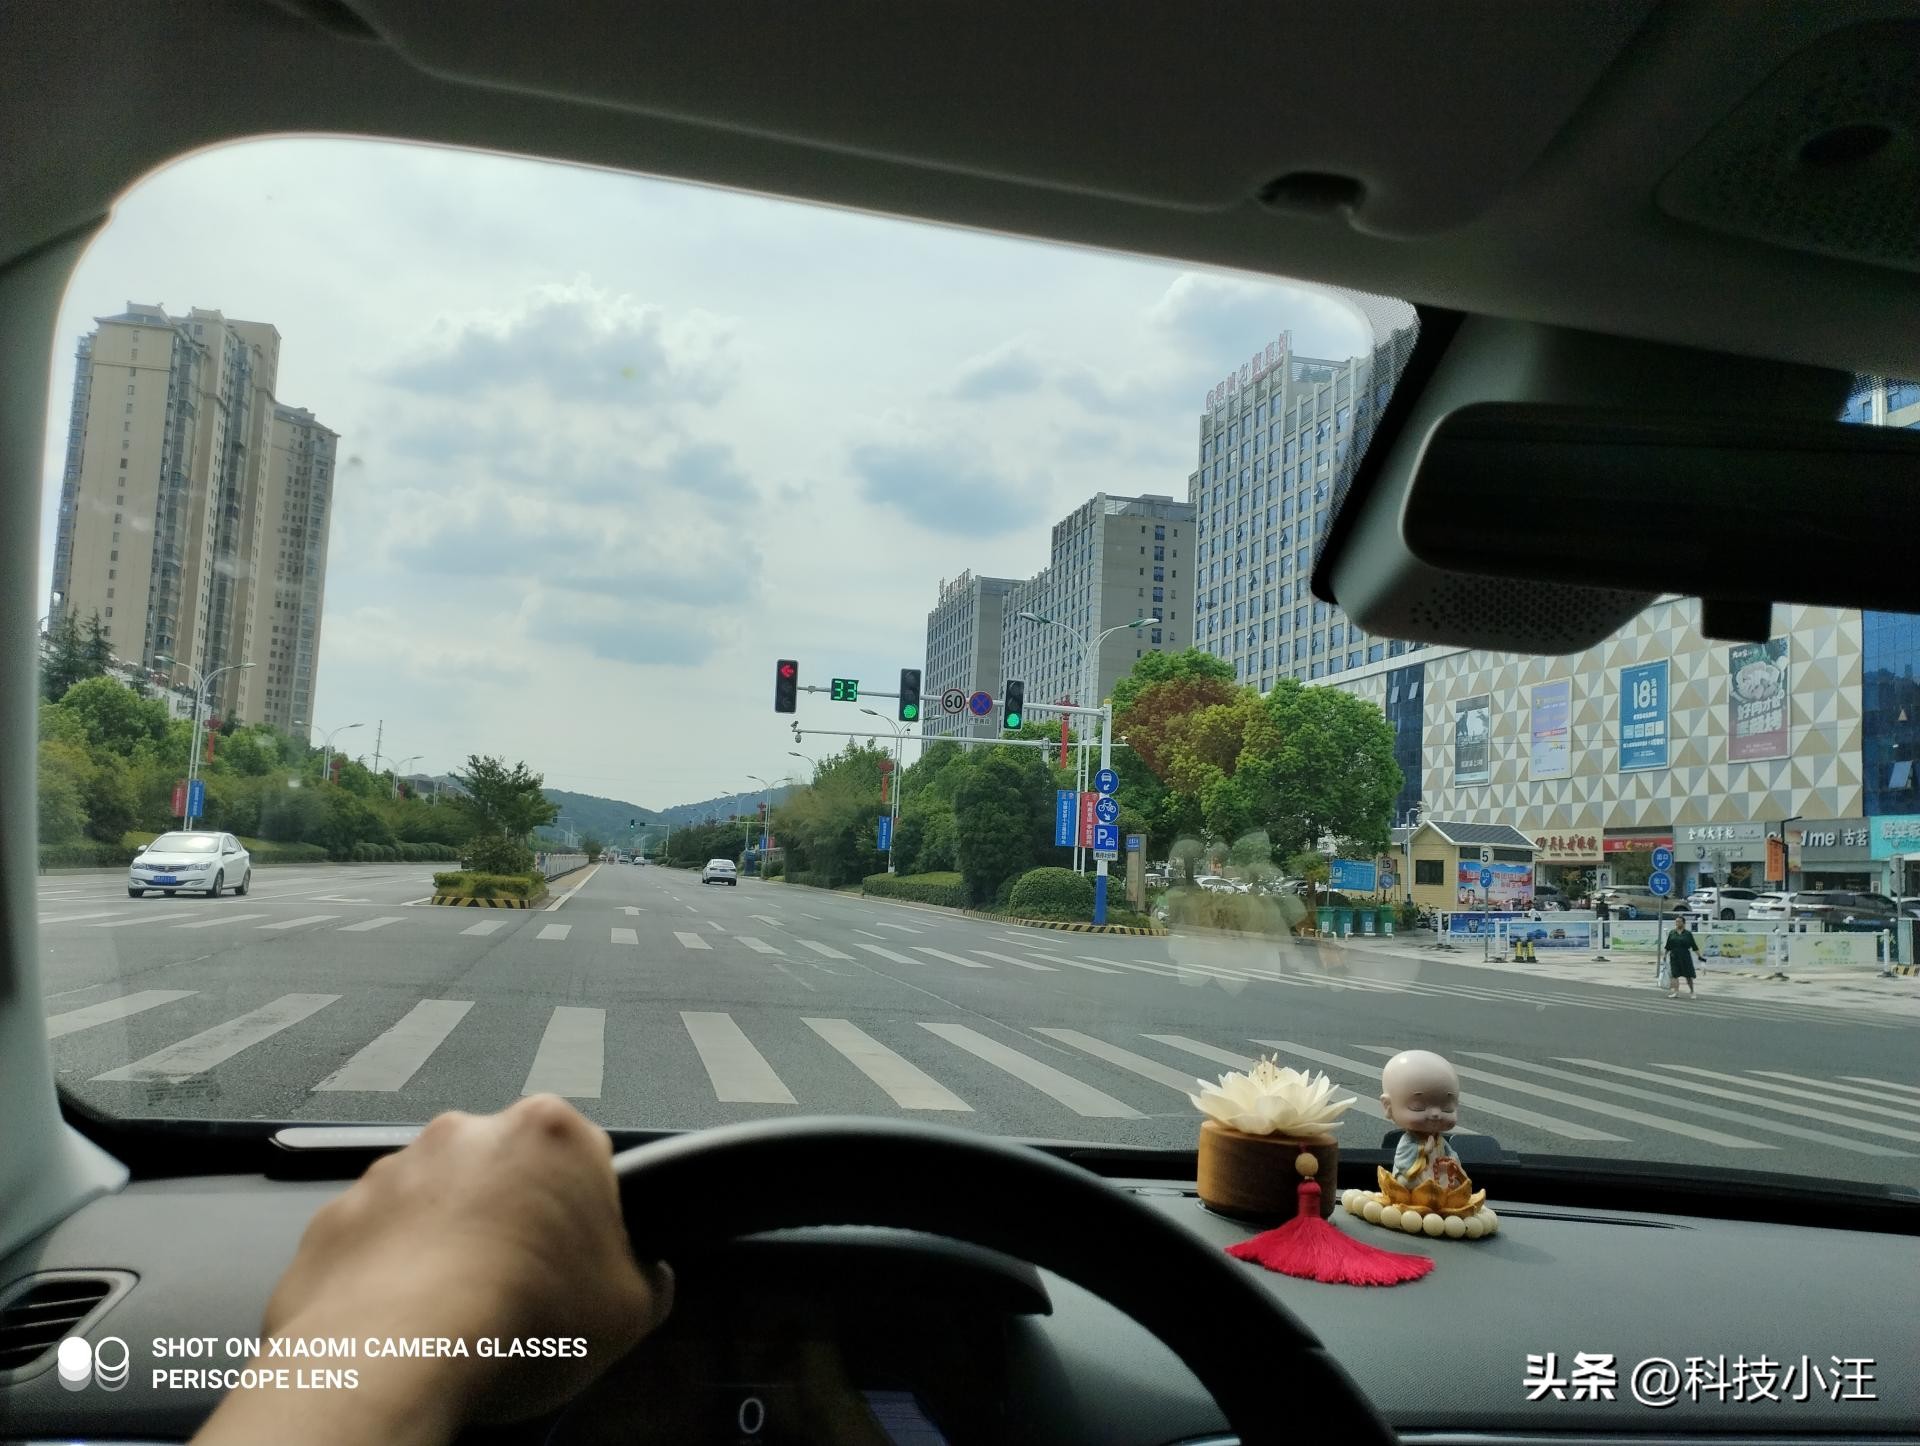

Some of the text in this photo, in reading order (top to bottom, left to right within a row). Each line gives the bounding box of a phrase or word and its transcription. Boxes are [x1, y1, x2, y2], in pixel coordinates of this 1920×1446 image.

[833, 680, 858, 701] 33
[1633, 679, 1651, 710] 18
[944, 694, 963, 710] 60
[1097, 828, 1108, 845] P
[1809, 831, 1835, 847] me
[1481, 850, 1489, 863] 5
[739, 1398, 764, 1434] 0
